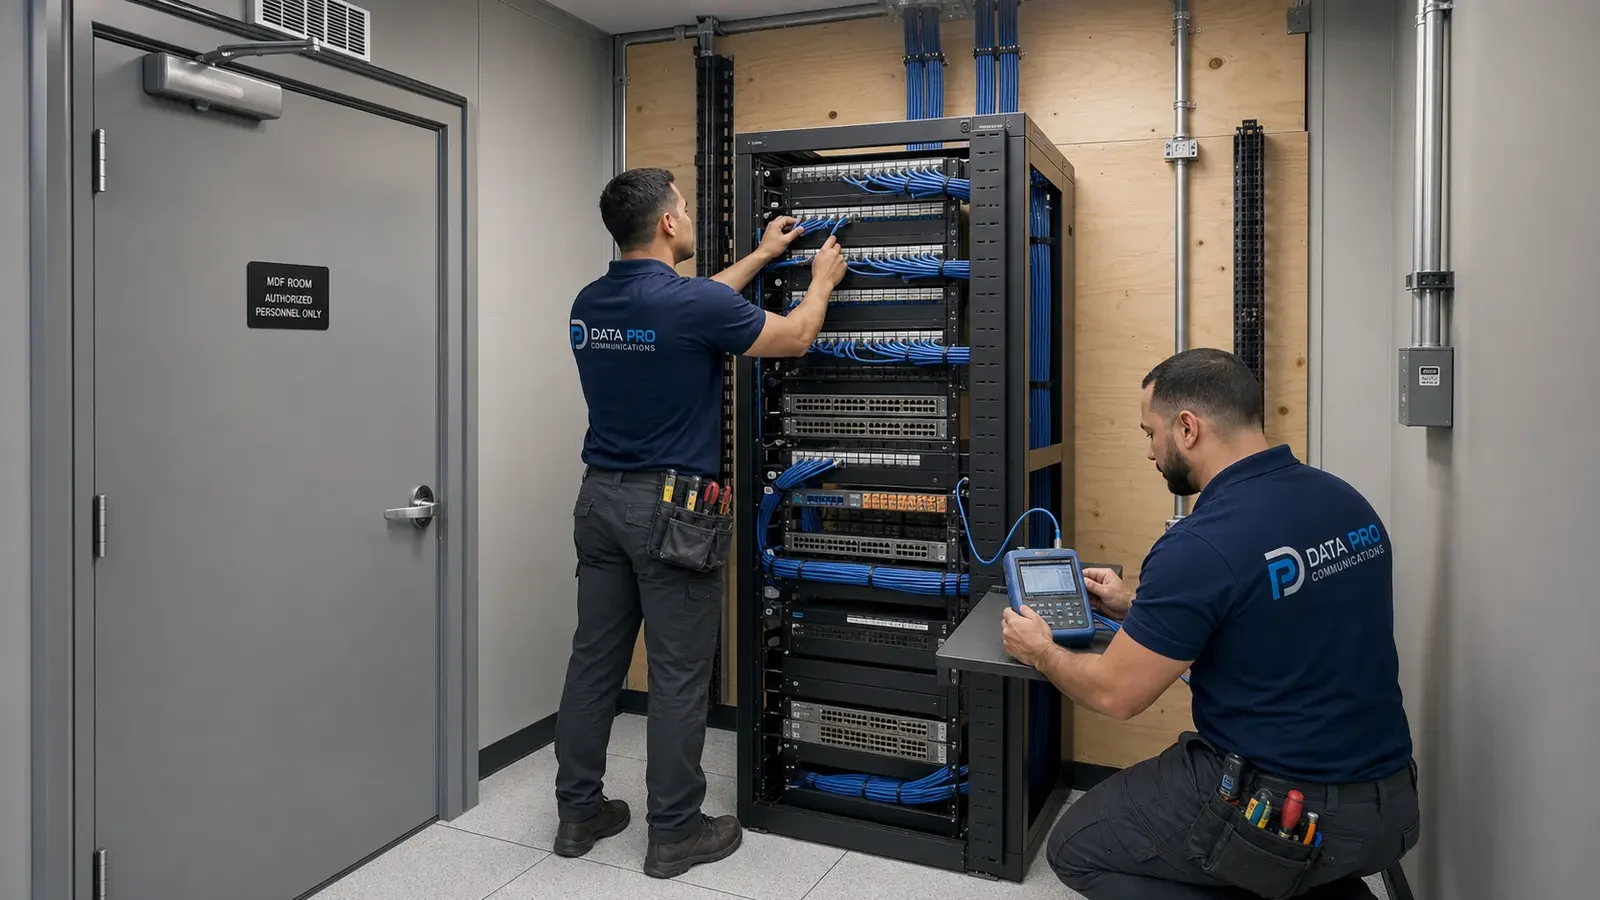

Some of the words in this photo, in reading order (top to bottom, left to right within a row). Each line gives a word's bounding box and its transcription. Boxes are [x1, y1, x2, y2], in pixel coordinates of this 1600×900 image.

[266, 276, 285, 287] MDF
[287, 278, 313, 288] ROOM
[264, 293, 313, 305] AUTHORIZED
[255, 307, 300, 318] PERSONNEL
[302, 309, 322, 319] ONLY
[591, 328, 623, 341] DATA
[626, 329, 656, 343] PRO
[590, 342, 656, 352] COMMUNICATIONS
[1305, 537, 1349, 568] DATA
[1347, 524, 1381, 550] PRO
[1311, 544, 1385, 582] COMMUNICATIONS
